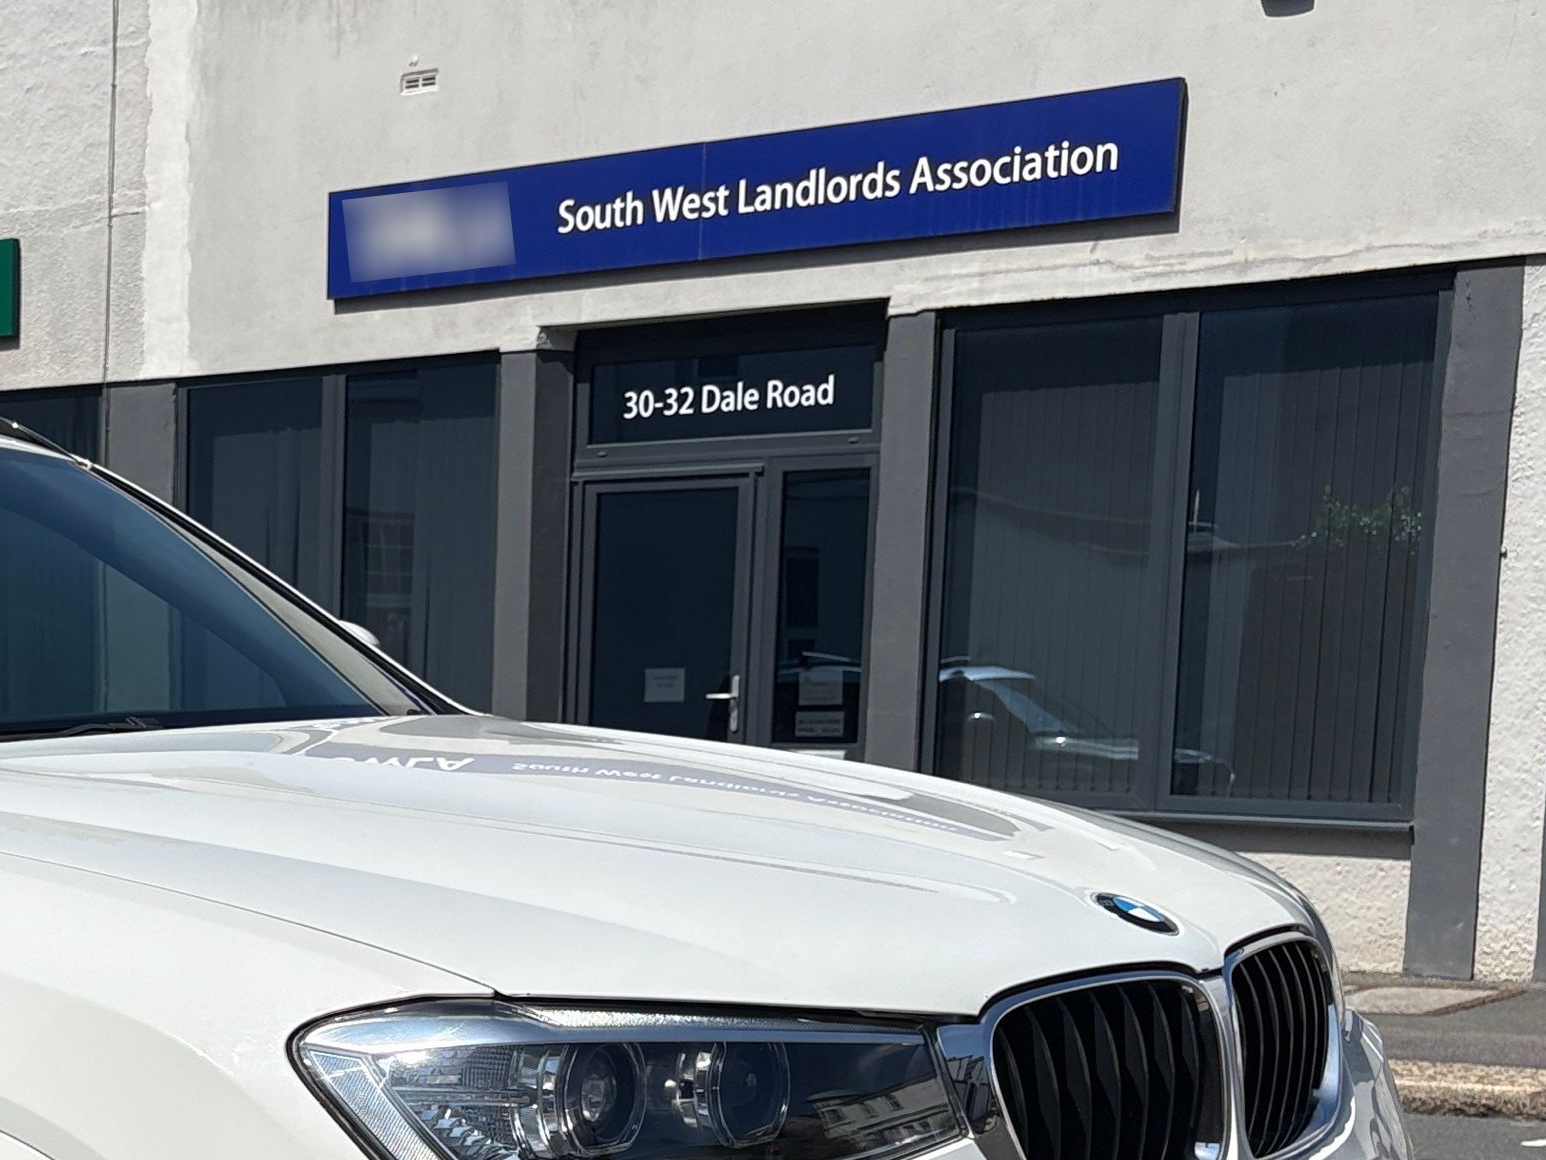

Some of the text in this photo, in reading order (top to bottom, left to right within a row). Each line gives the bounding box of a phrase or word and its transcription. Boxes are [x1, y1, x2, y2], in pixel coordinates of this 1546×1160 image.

[557, 189, 644, 234] South
[652, 184, 730, 223] West
[738, 161, 901, 214] Landlords
[909, 140, 1119, 195] Association
[623, 374, 836, 420] 30-32 Dale Road
